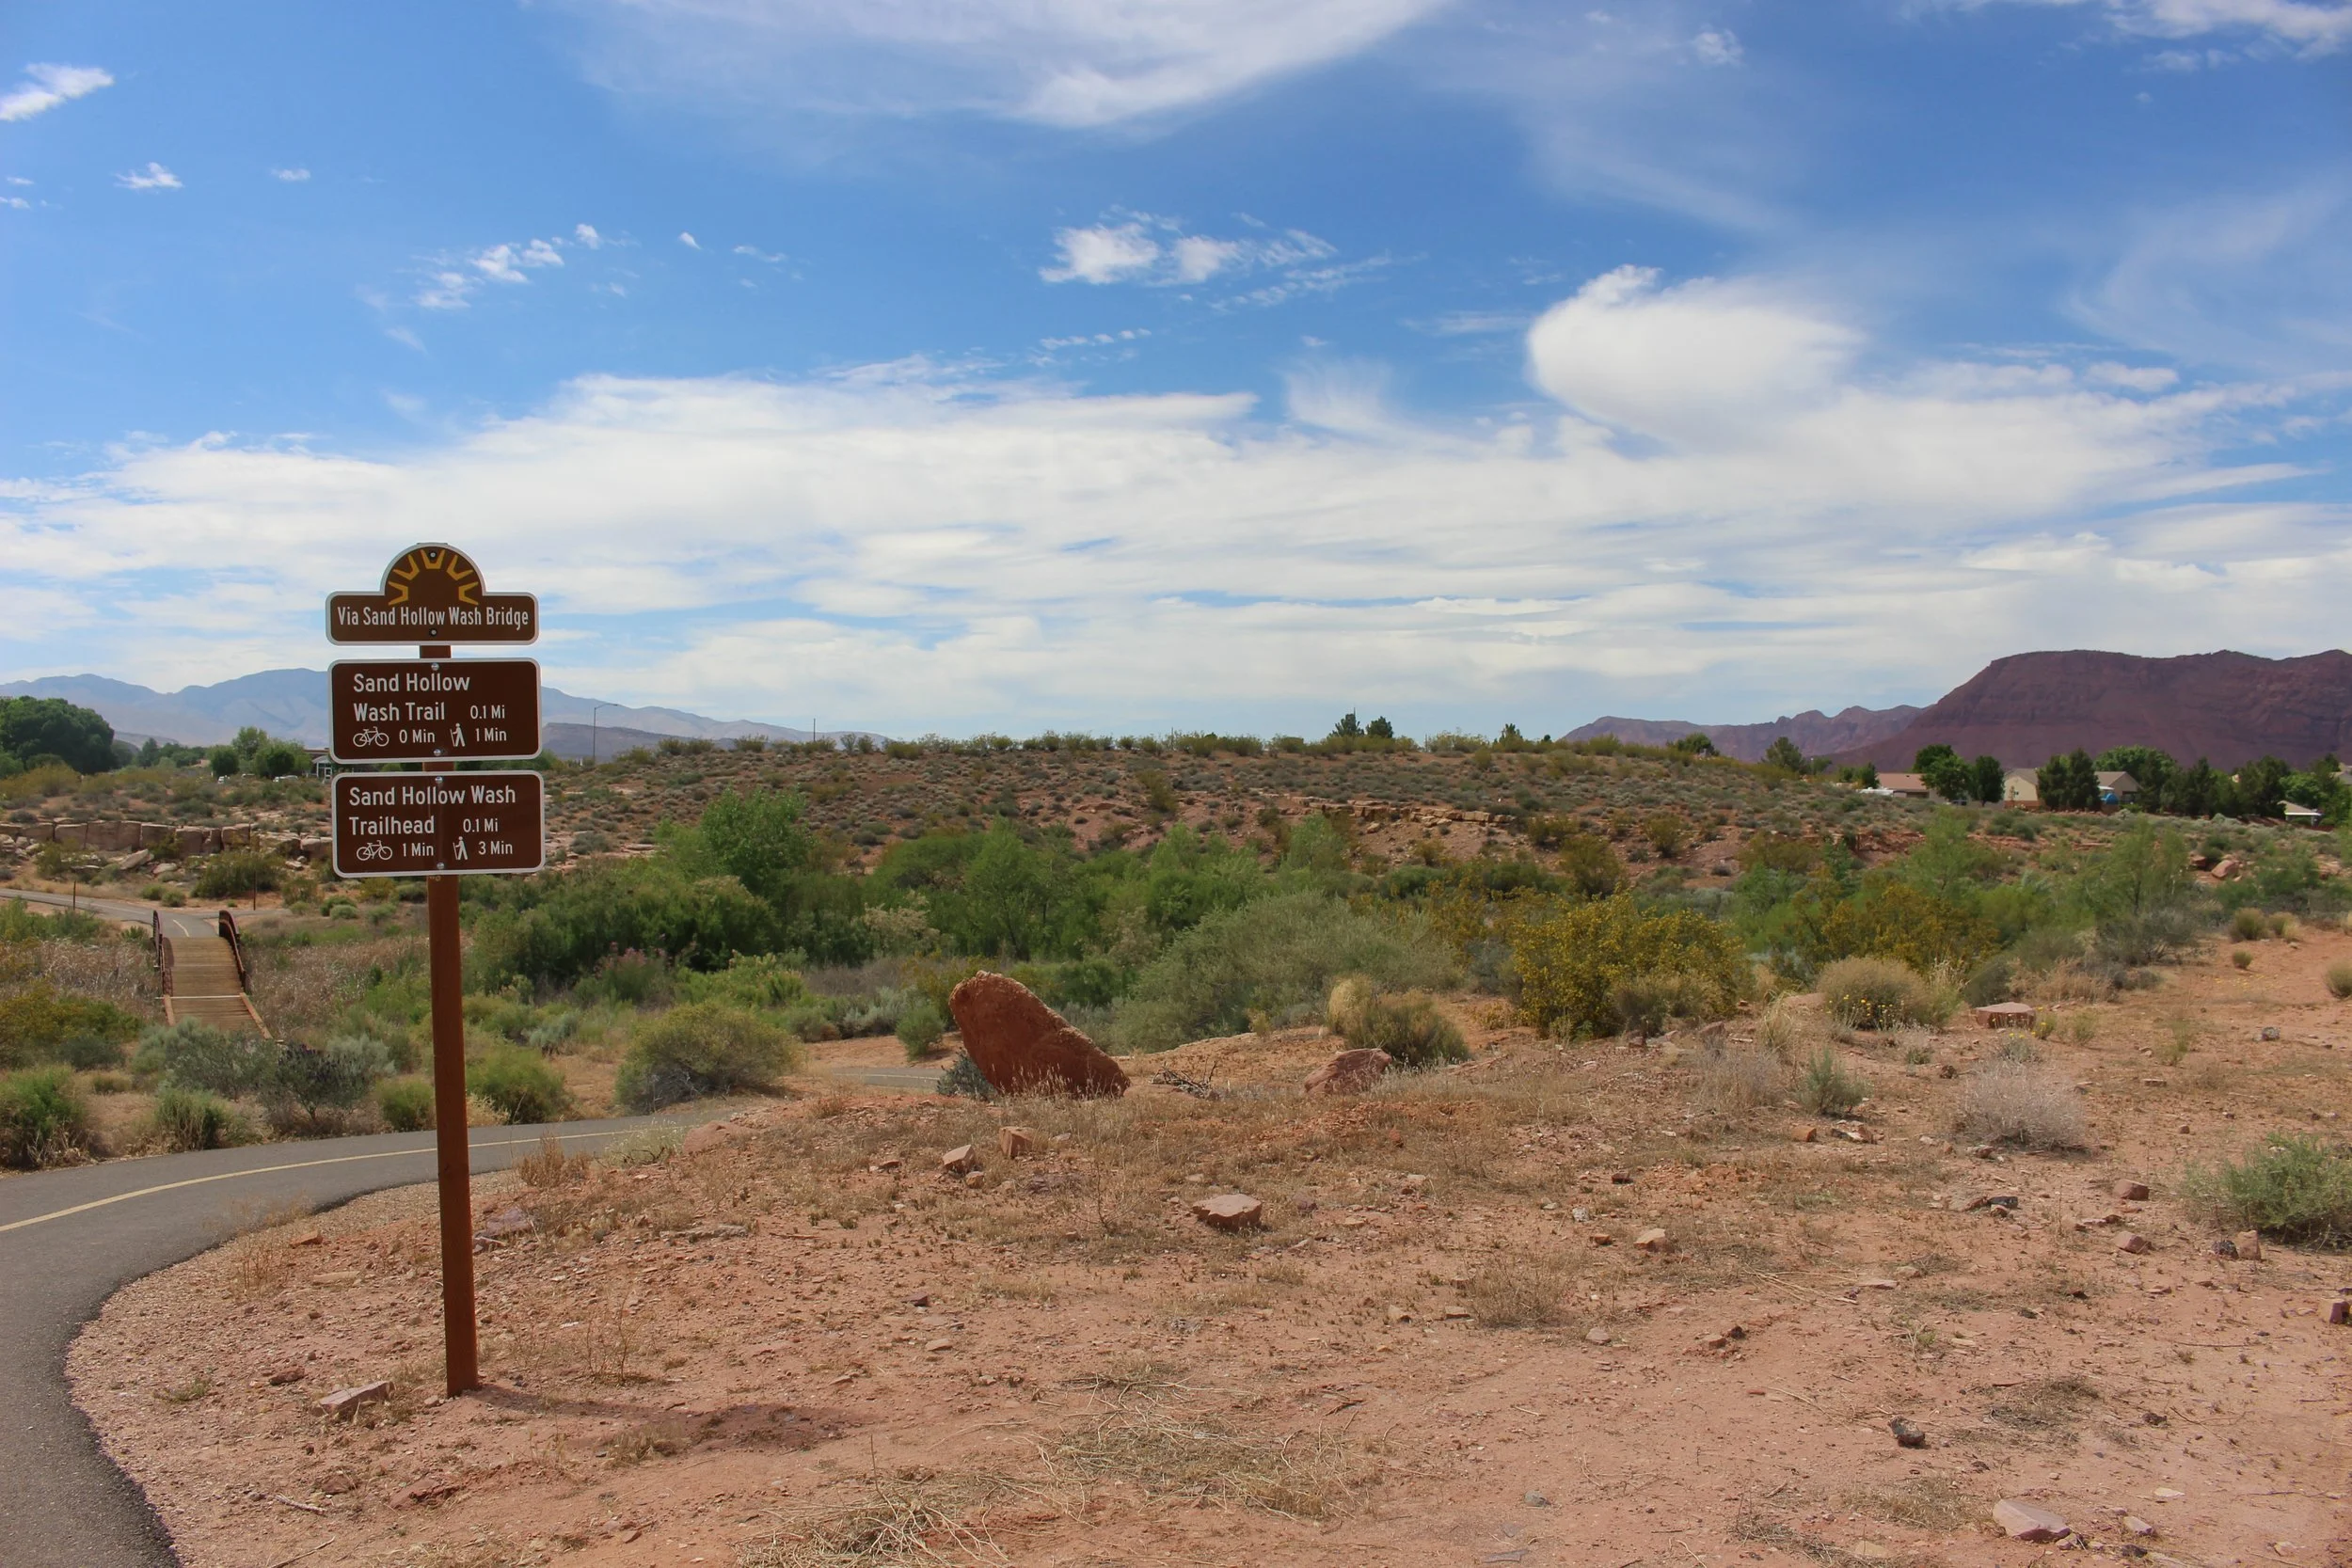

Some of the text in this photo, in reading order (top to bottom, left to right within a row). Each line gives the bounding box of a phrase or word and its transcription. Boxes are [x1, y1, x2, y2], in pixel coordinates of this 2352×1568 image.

[338, 607, 529, 631] Via Sand Hollow Wash Bridge
[353, 673, 470, 692] Sand Hollow
[354, 702, 445, 721] Wash Trail
[470, 705, 505, 720] 0.1 Mi
[399, 729, 436, 743] 0 Min
[485, 727, 507, 742] Min
[349, 784, 516, 806] Sand Hollow Wash
[349, 816, 435, 835] Trailhead
[463, 818, 498, 832] 0.1 Mi
[412, 843, 434, 857] Min
[478, 841, 513, 855] 3 Min
